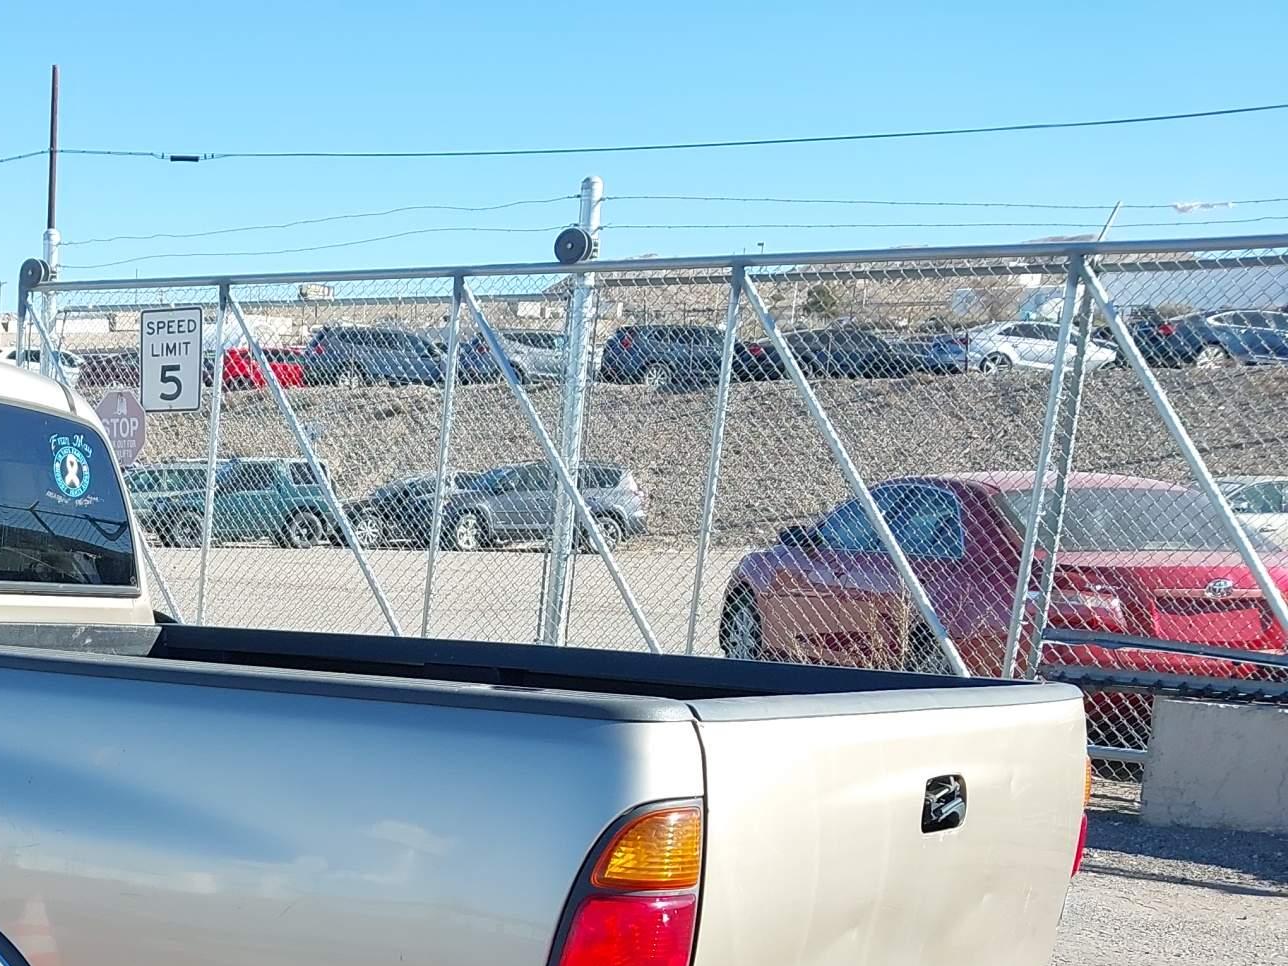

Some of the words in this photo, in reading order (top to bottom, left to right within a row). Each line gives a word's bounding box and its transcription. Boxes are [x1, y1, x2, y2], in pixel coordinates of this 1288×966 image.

[146, 319, 197, 336] SPEED
[151, 341, 192, 358] LIMIT
[159, 364, 183, 401] 5
